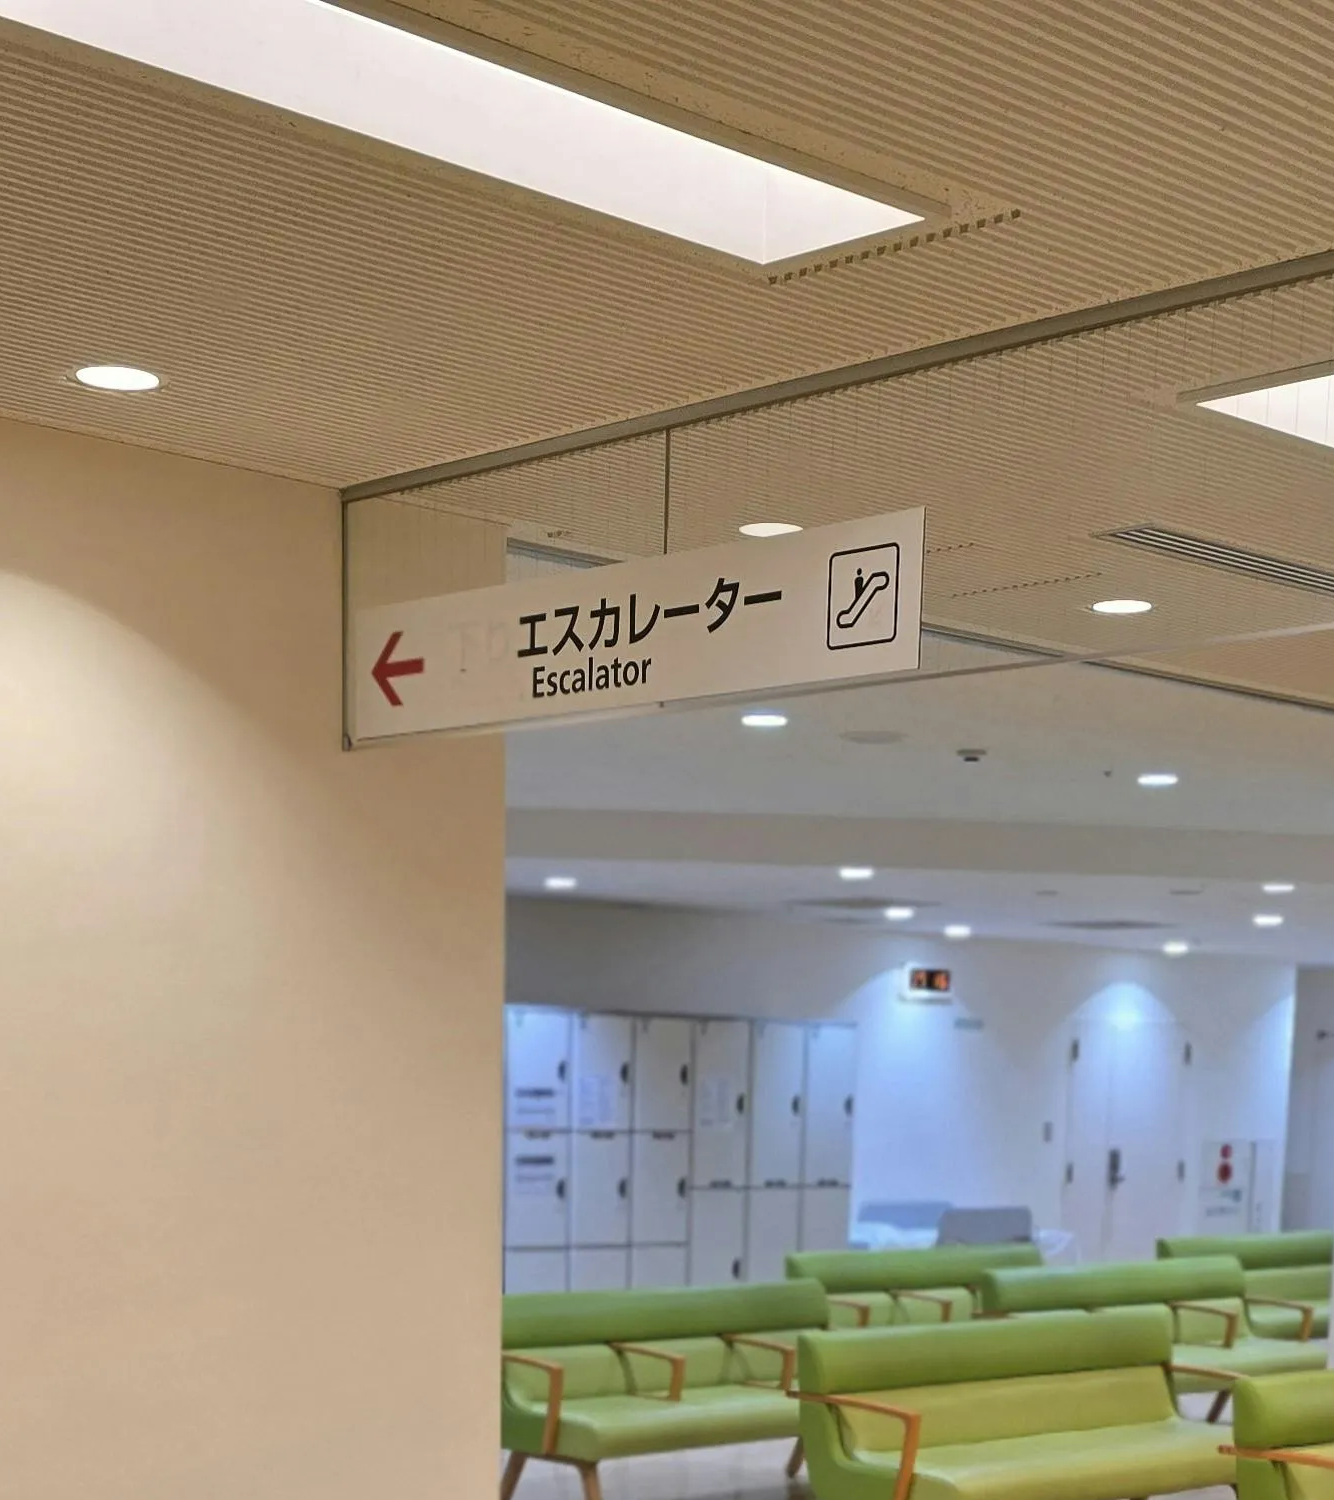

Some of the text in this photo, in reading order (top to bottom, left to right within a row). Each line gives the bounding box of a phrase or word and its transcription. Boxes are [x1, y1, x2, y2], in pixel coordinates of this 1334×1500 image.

[517, 577, 783, 658] エスカレーター
[532, 655, 653, 698] Escalator
